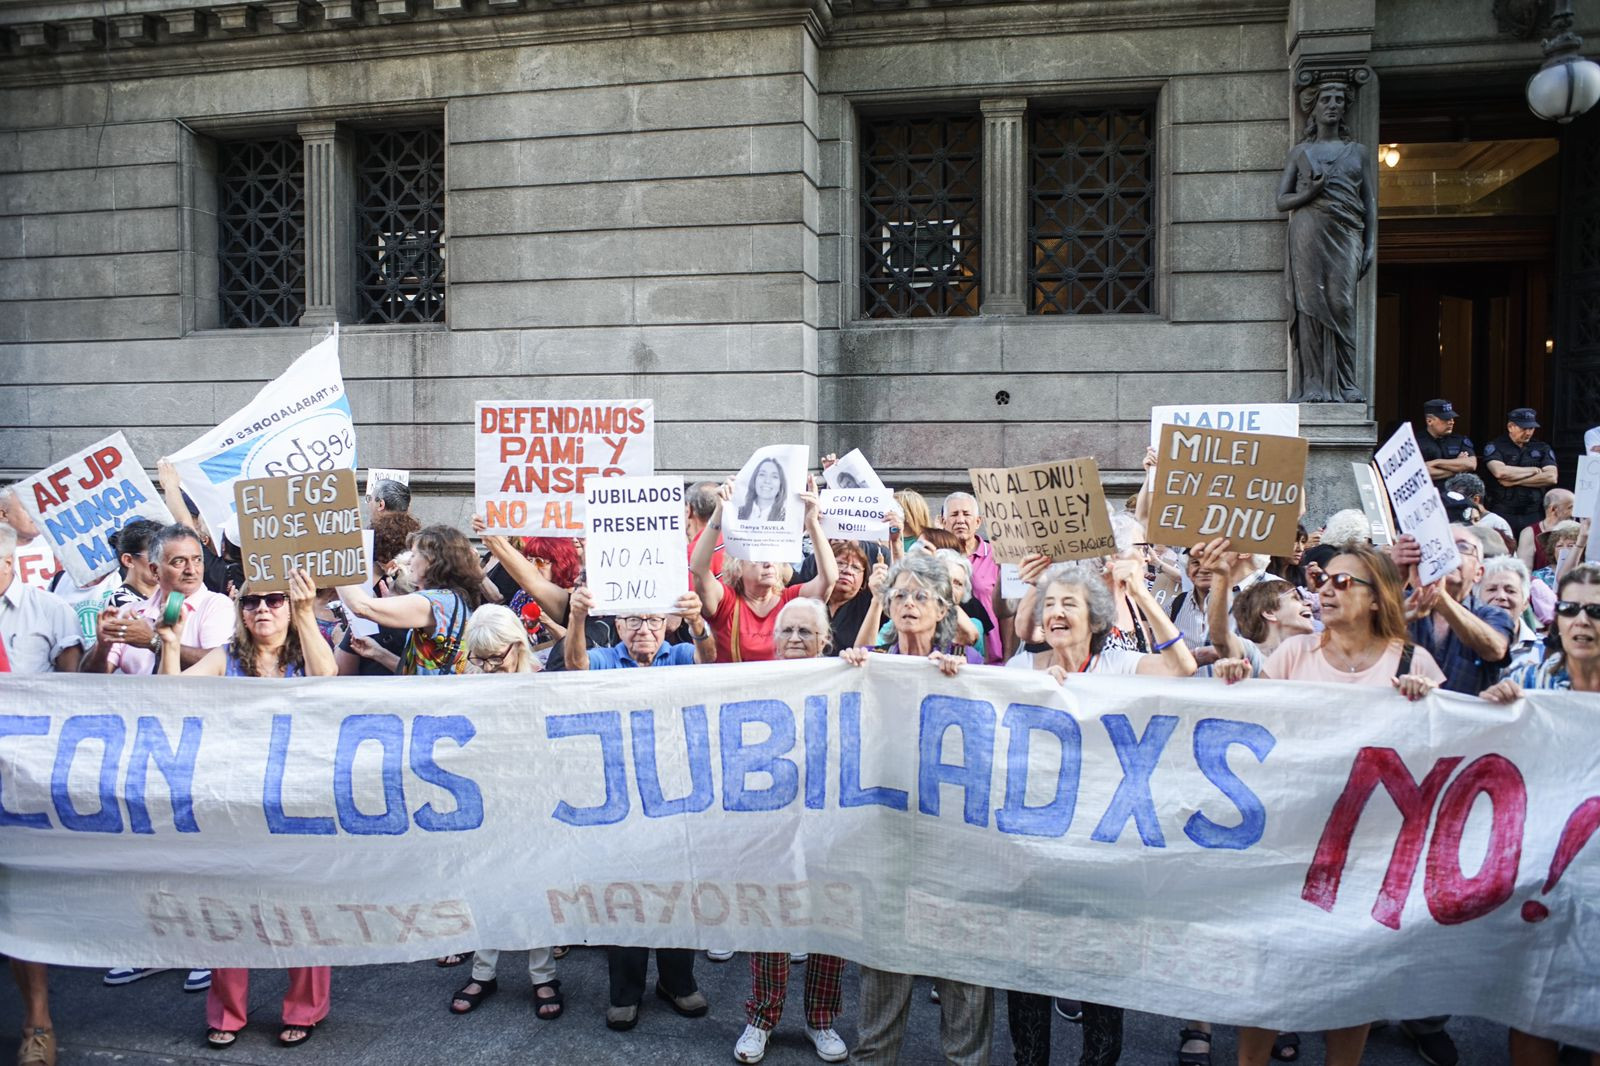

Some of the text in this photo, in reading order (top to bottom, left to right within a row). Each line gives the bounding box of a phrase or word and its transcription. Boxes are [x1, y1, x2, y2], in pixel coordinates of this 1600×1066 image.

[481, 406, 645, 435] DEFENDAMOS
[1173, 411, 1261, 431] NADIE
[602, 436, 628, 465] Y
[1170, 430, 1261, 466] MILEI
[1383, 437, 1417, 480] JUBILADOS
[241, 473, 338, 515] EL FGS
[588, 487, 683, 505] JUBILADOS
[977, 473, 1000, 494] NO
[1007, 472, 1029, 494] AL
[1166, 470, 1299, 505] EN EL CULO
[1392, 468, 1428, 507] PRESENTE
[44, 478, 147, 546] NUNCA
[822, 508, 885, 519] JUBILADOS
[832, 495, 855, 503] CON
[984, 493, 1090, 520] NO A LA LEY
[253, 508, 361, 540] NO SE VENDE
[485, 501, 584, 530] NO AL
[593, 515, 680, 533] PRESENTE
[1159, 504, 1276, 541] EL DNU
[248, 546, 368, 582] SE DEFIENDE
[600, 547, 665, 568] NO AL
[263, 714, 484, 836] LOS
[545, 692, 1277, 850] JUBILADXS
[546, 882, 857, 930] MAYORES
